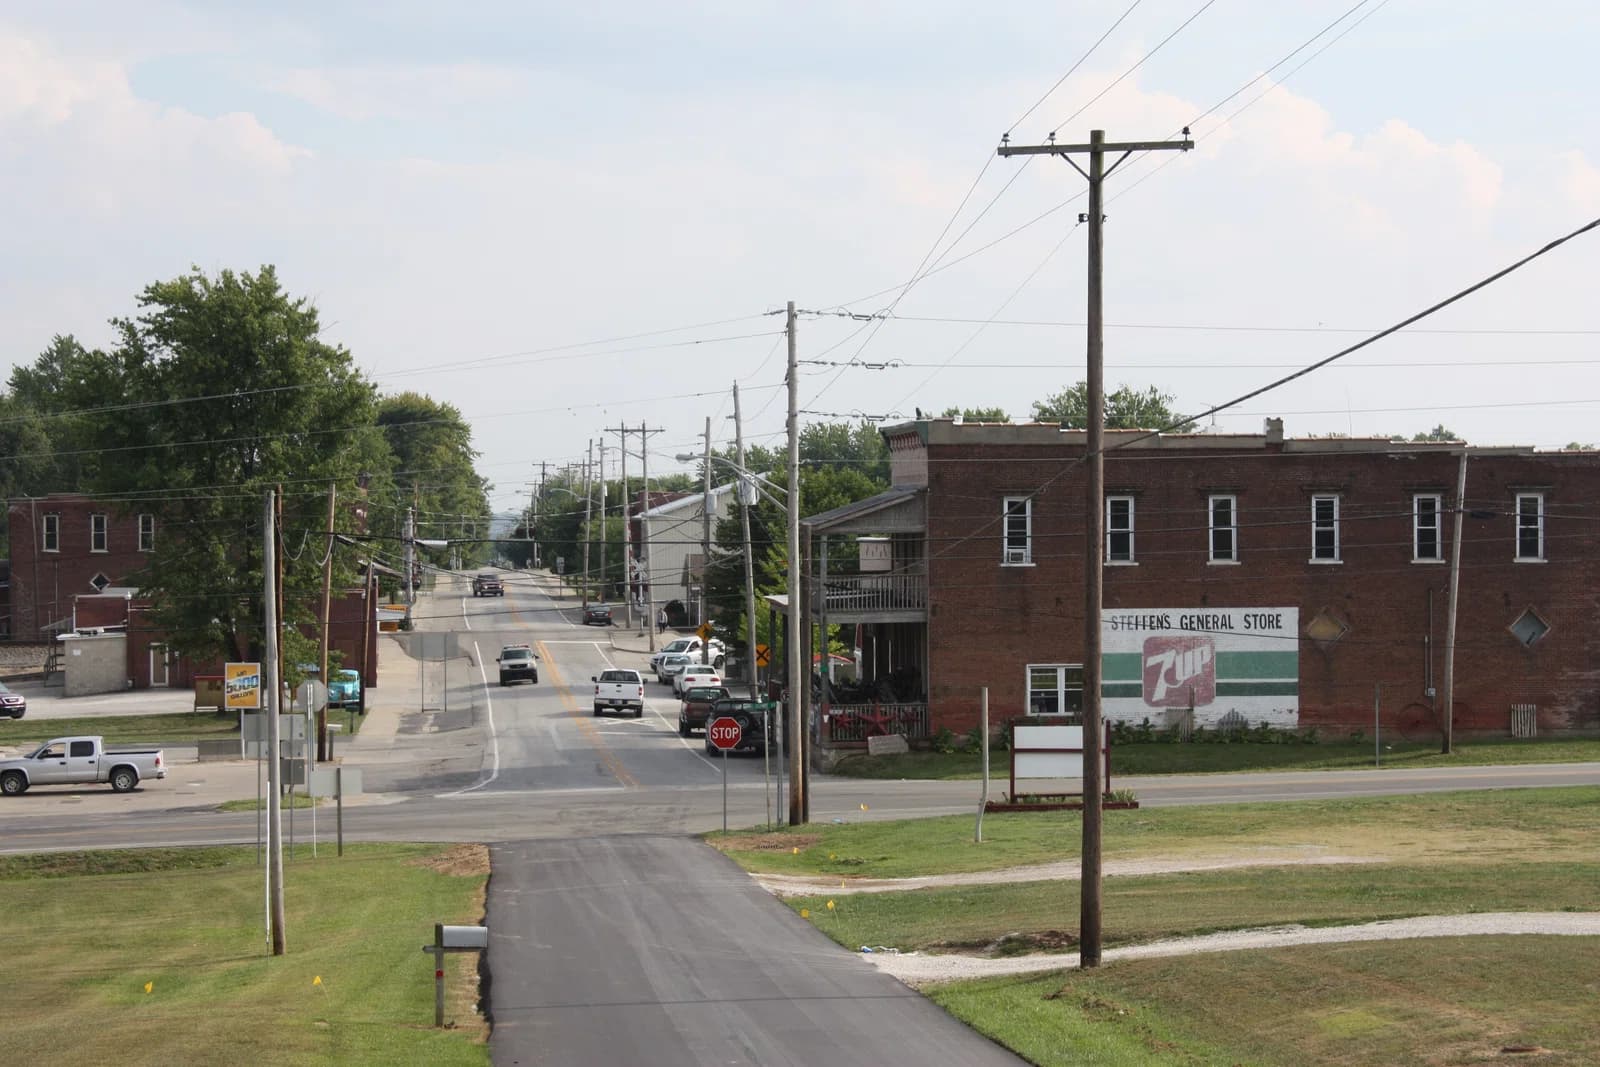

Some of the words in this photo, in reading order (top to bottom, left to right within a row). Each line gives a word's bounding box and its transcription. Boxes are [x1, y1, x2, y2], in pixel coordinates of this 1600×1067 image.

[1180, 614, 1234, 631] GENERAL
[1243, 613, 1283, 630] STORE
[712, 727, 739, 739] STOP
